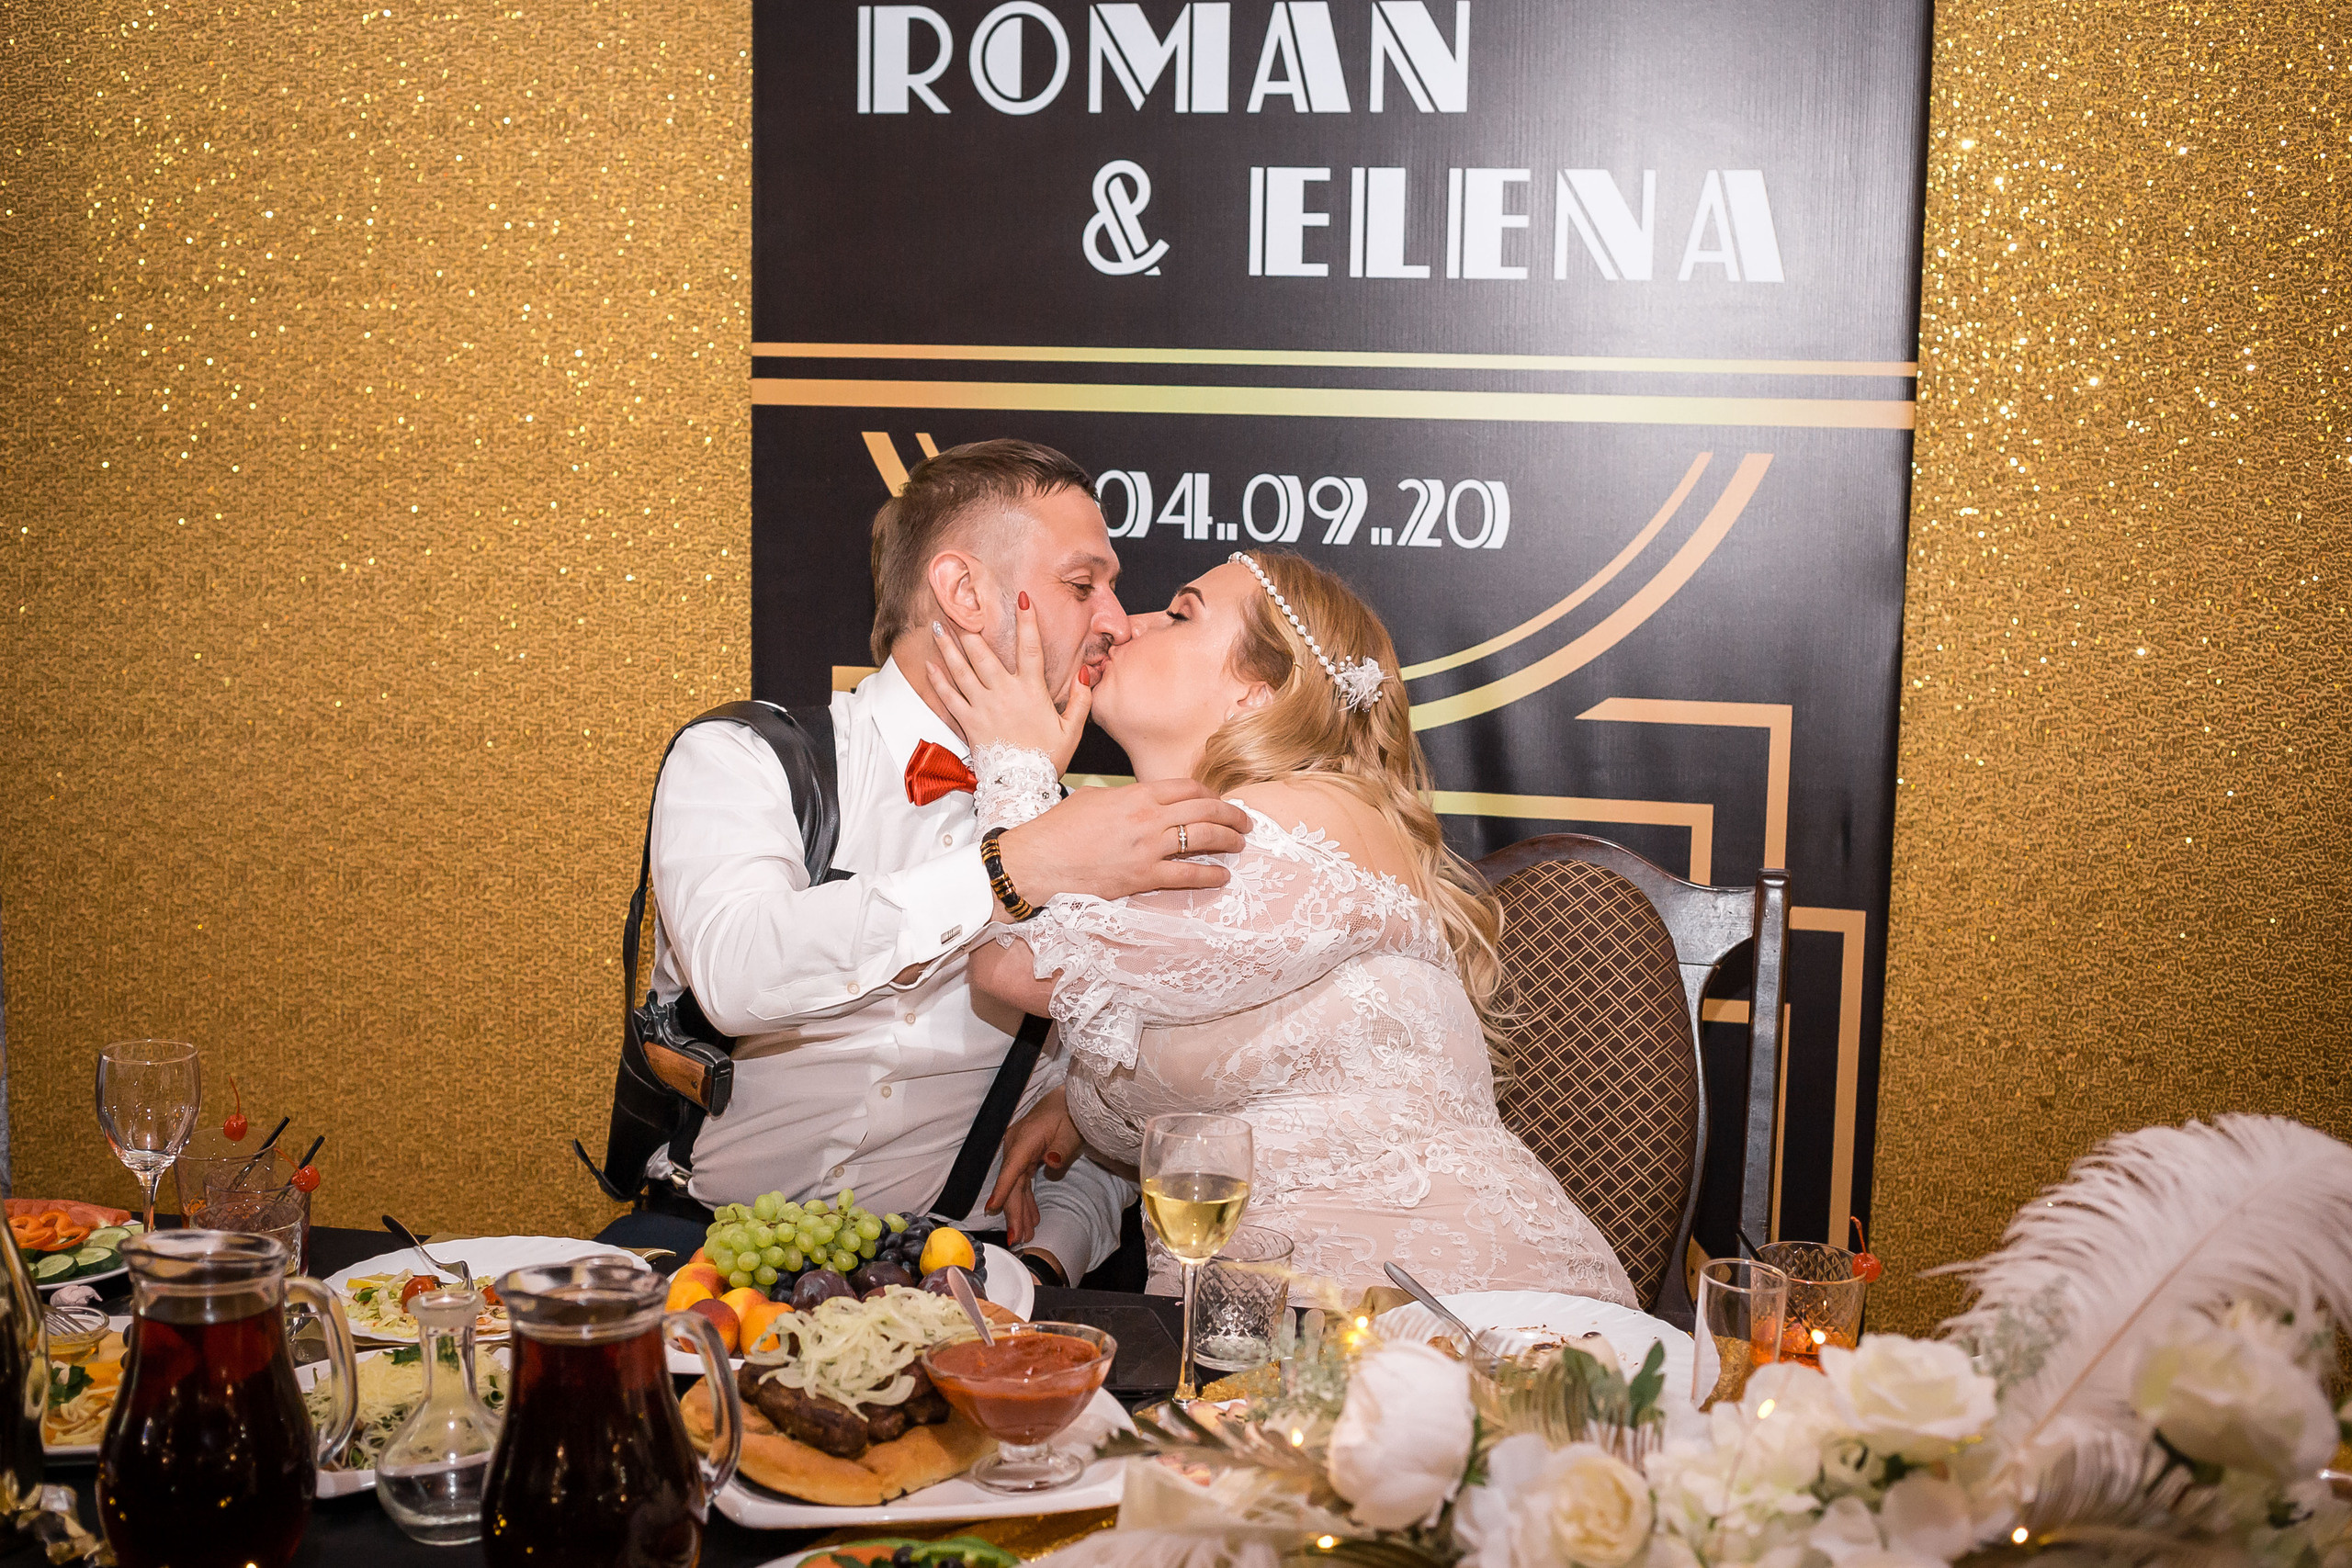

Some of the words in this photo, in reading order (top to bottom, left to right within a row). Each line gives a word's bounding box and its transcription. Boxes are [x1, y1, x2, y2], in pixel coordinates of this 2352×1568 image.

[857, 1, 1469, 115] ROMAN
[1082, 160, 1170, 276] &
[1249, 166, 1785, 283] ELENA
